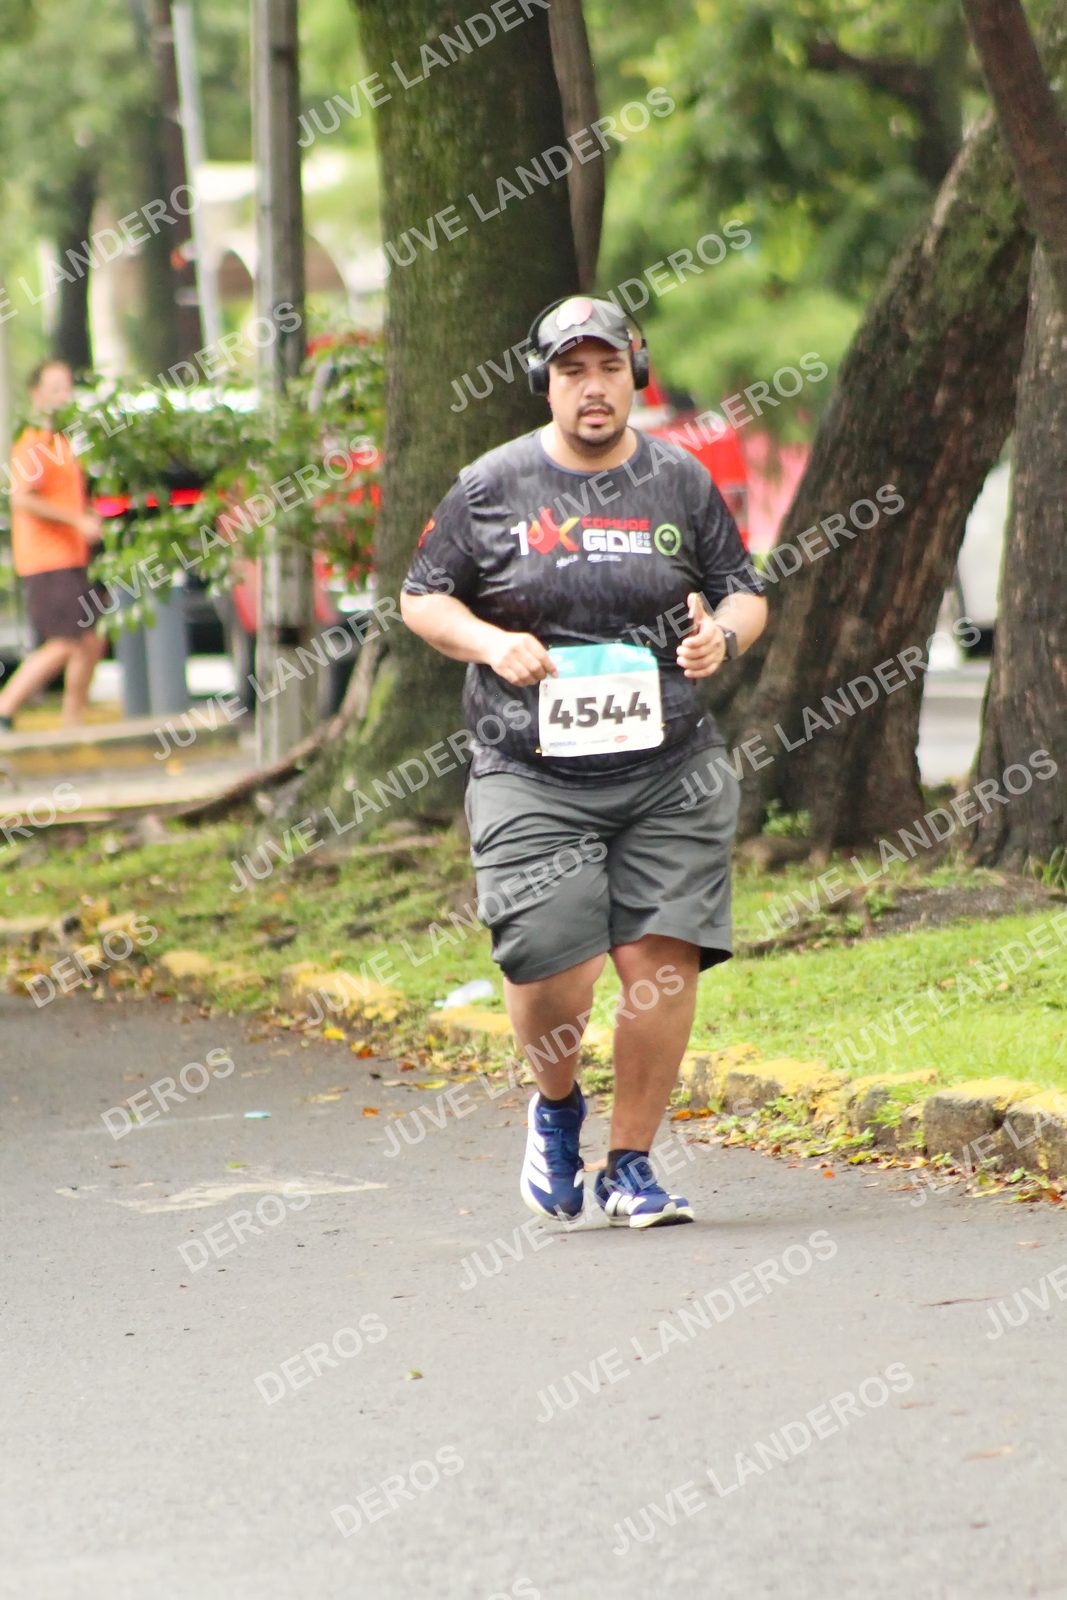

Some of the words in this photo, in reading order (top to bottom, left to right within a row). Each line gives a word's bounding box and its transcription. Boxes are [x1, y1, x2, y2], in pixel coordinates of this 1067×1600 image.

[581, 516, 650, 531] COMUDE
[583, 529, 652, 554] GDL
[549, 691, 651, 729] 4544
